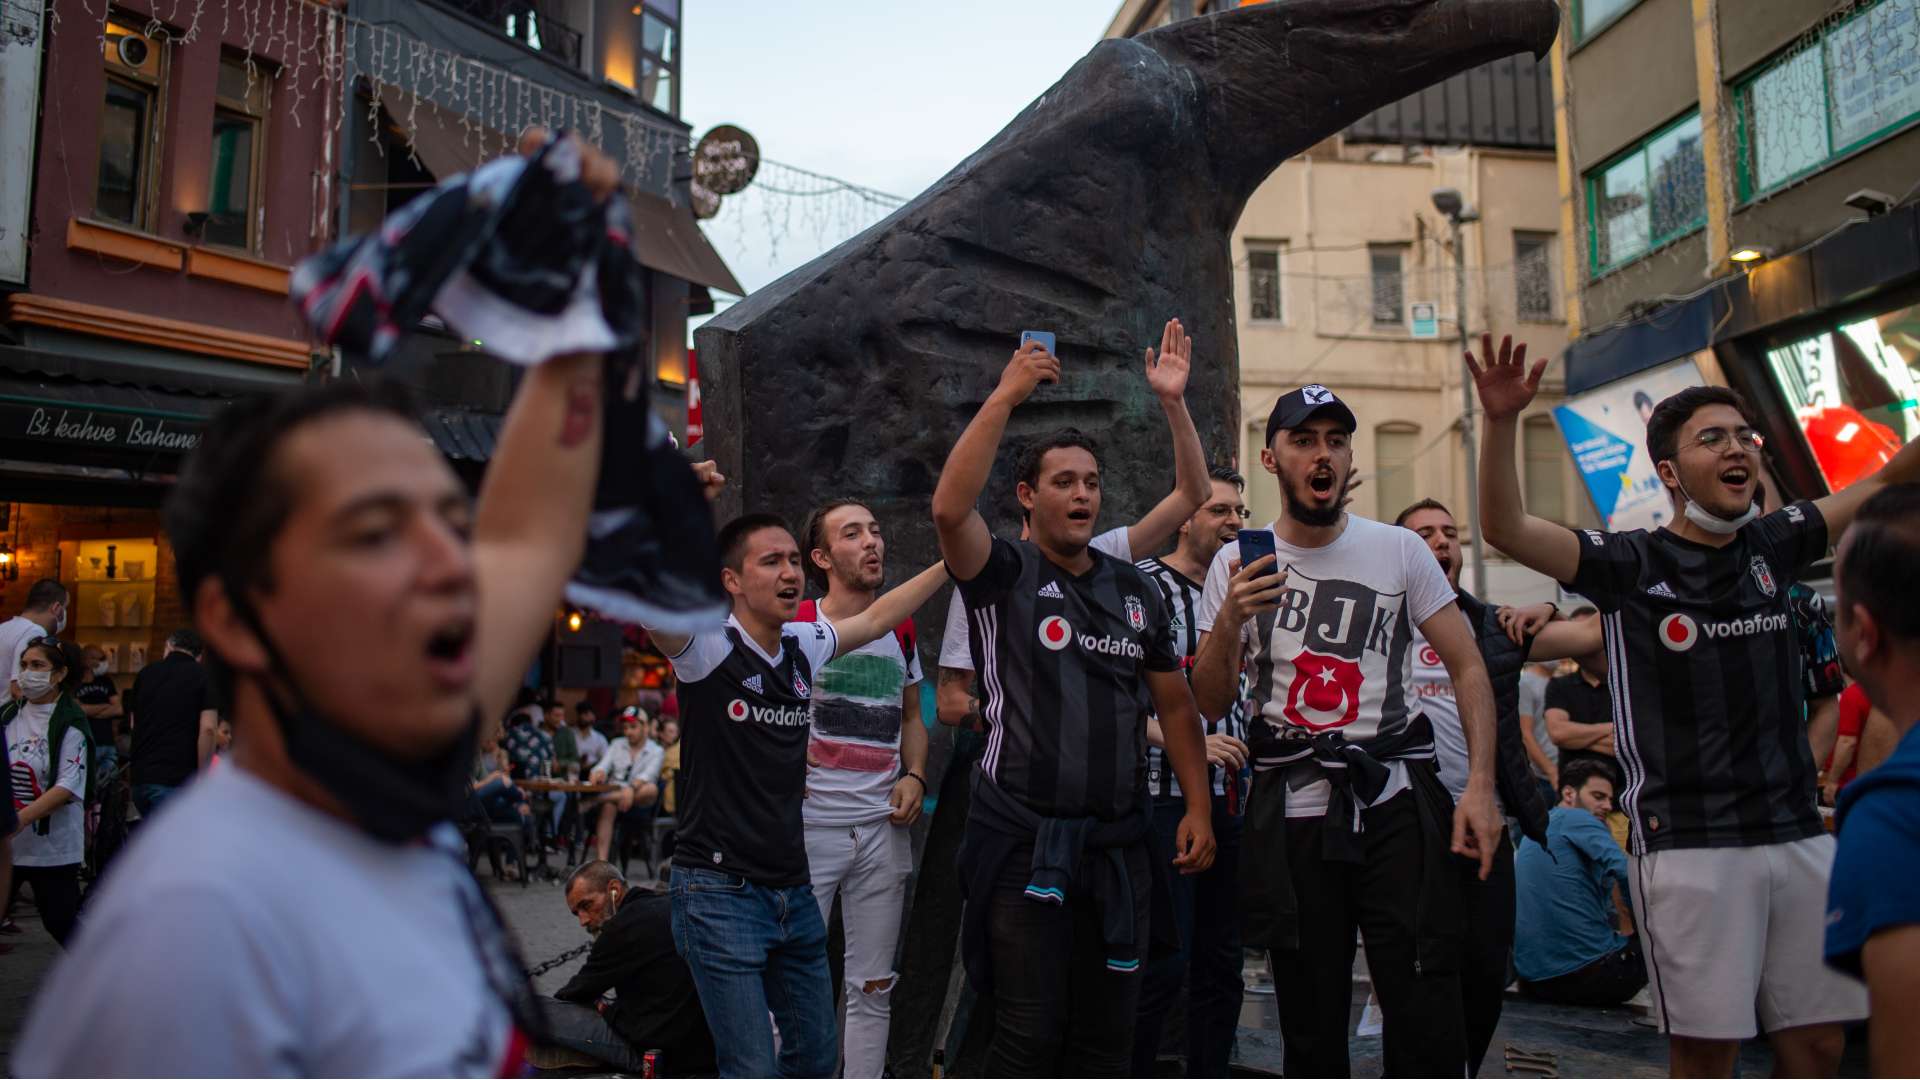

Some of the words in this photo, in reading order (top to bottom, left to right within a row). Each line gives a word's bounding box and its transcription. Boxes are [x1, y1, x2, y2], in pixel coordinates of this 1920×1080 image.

[26, 407, 51, 436] Bi
[54, 409, 117, 442] kahve
[1038, 590, 1064, 599] adidas
[752, 704, 813, 727] vodafo
